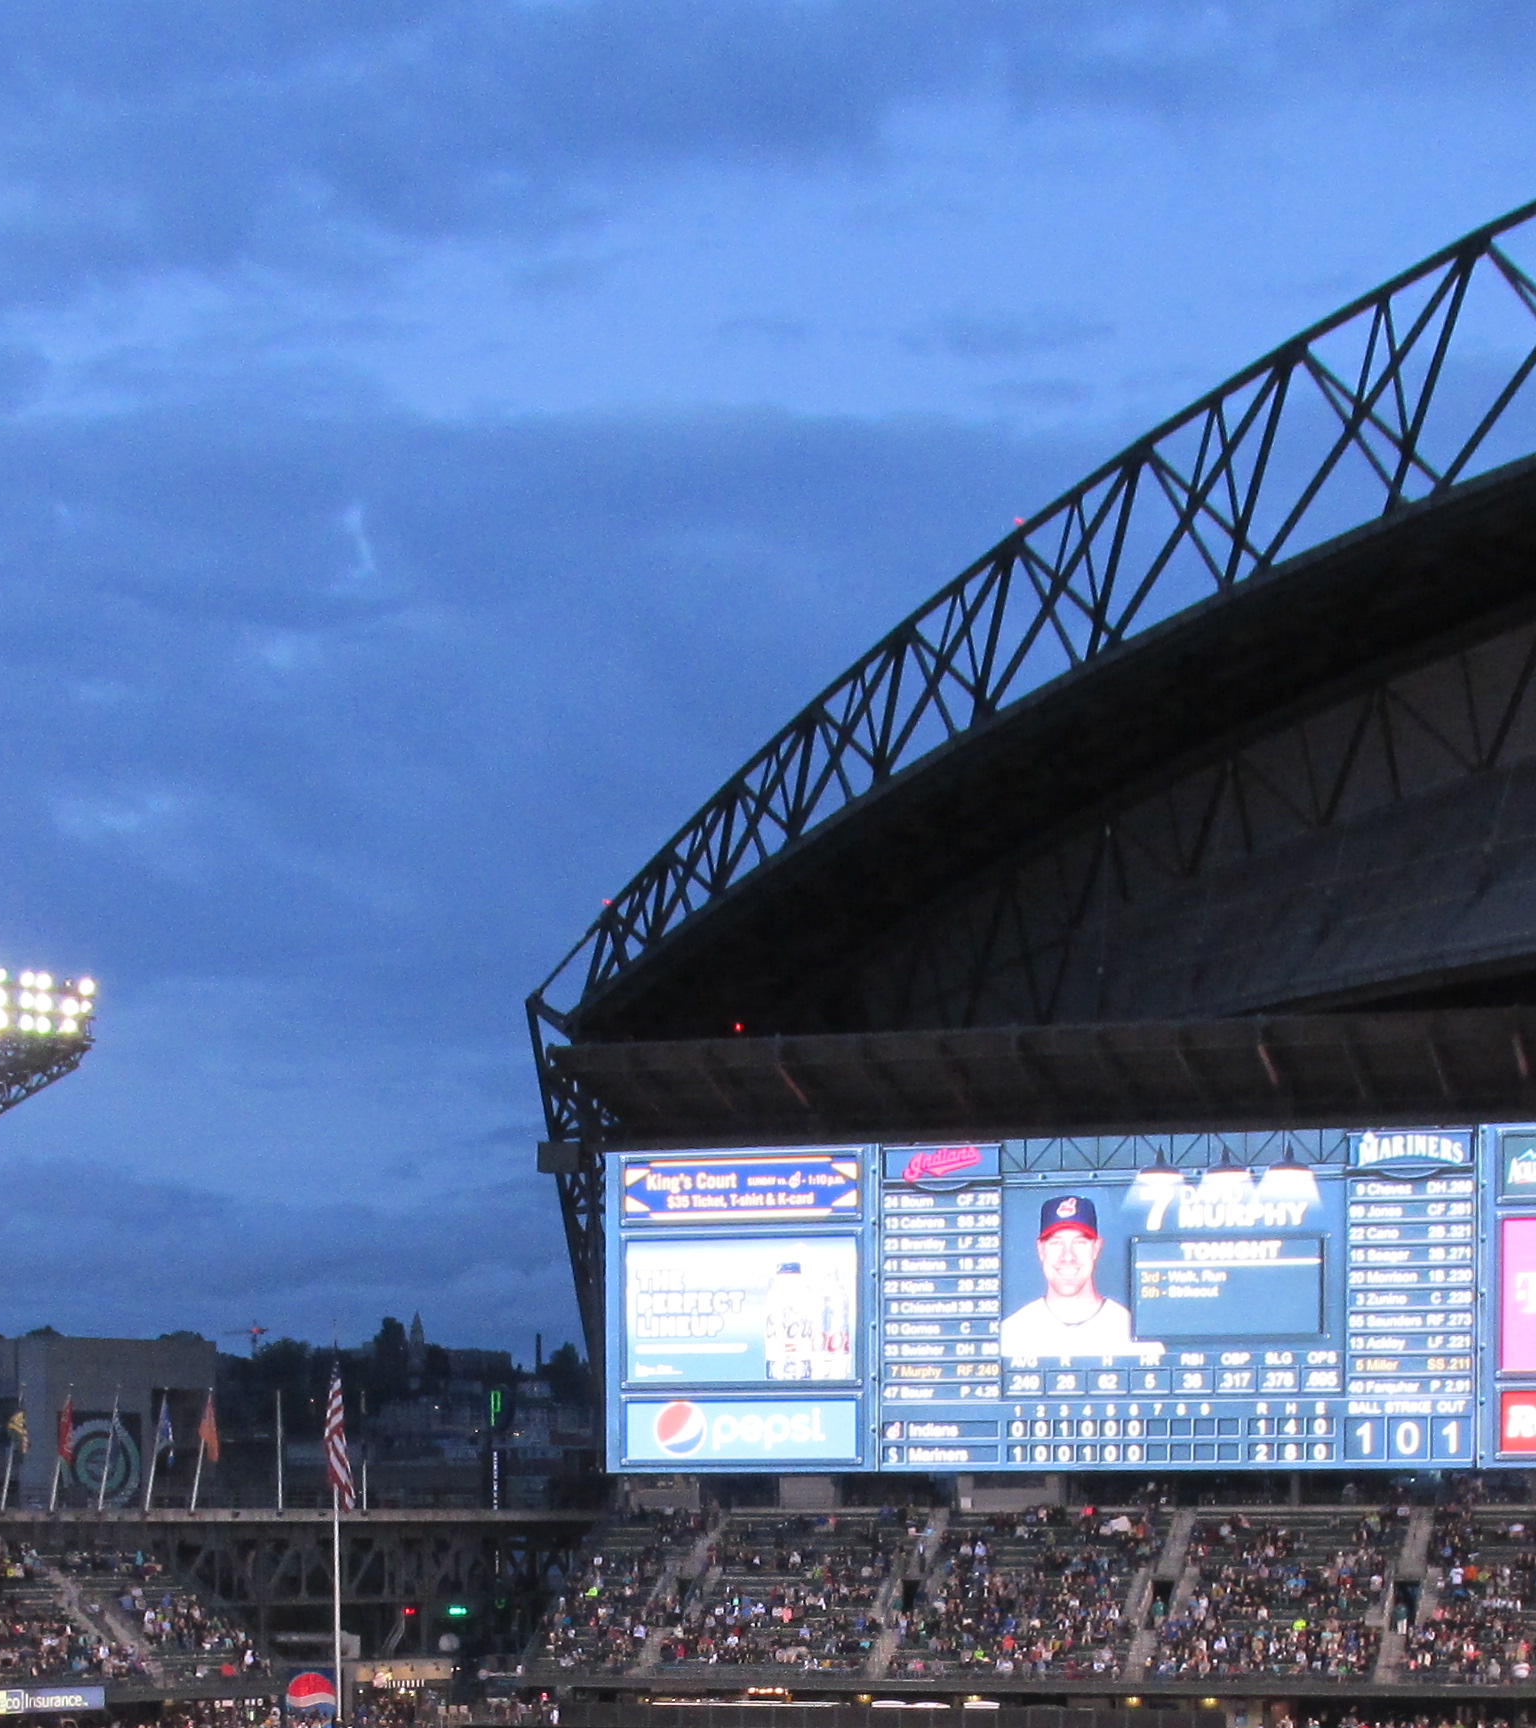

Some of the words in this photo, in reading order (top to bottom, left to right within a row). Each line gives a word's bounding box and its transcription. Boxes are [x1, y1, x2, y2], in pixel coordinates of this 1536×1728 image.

[1358, 1134, 1464, 1166] MARINERS
[904, 1147, 981, 1181] Indians
[646, 1174, 692, 1193] King's
[696, 1172, 738, 1190] Court
[808, 1174, 827, 1186] 1:10
[668, 1196, 689, 1208] $35
[730, 1194, 764, 1207] T-shirt
[778, 1192, 814, 1205] K-card
[1140, 1187, 1174, 1230] 7
[1179, 1202, 1307, 1228] MURPHY
[1181, 1240, 1282, 1260] TONIGHT
[636, 1269, 685, 1292] THE
[1141, 1271, 1160, 1283] 3rd
[1202, 1270, 1226, 1282] Run
[636, 1290, 745, 1314] PERFECT
[636, 1314, 724, 1338] LINEUP
[901, 1366, 942, 1379] Murphy
[1366, 1359, 1398, 1370] Miller
[1348, 1402, 1382, 1414] BALL
[1384, 1400, 1432, 1414] STRIKE
[1437, 1400, 1466, 1412] OUT
[712, 1407, 826, 1451] pepsi
[1356, 1422, 1372, 1454] 1
[1396, 1421, 1420, 1455] 0
[1442, 1421, 1460, 1454] 1
[25, 1694, 82, 1708] Insurance
